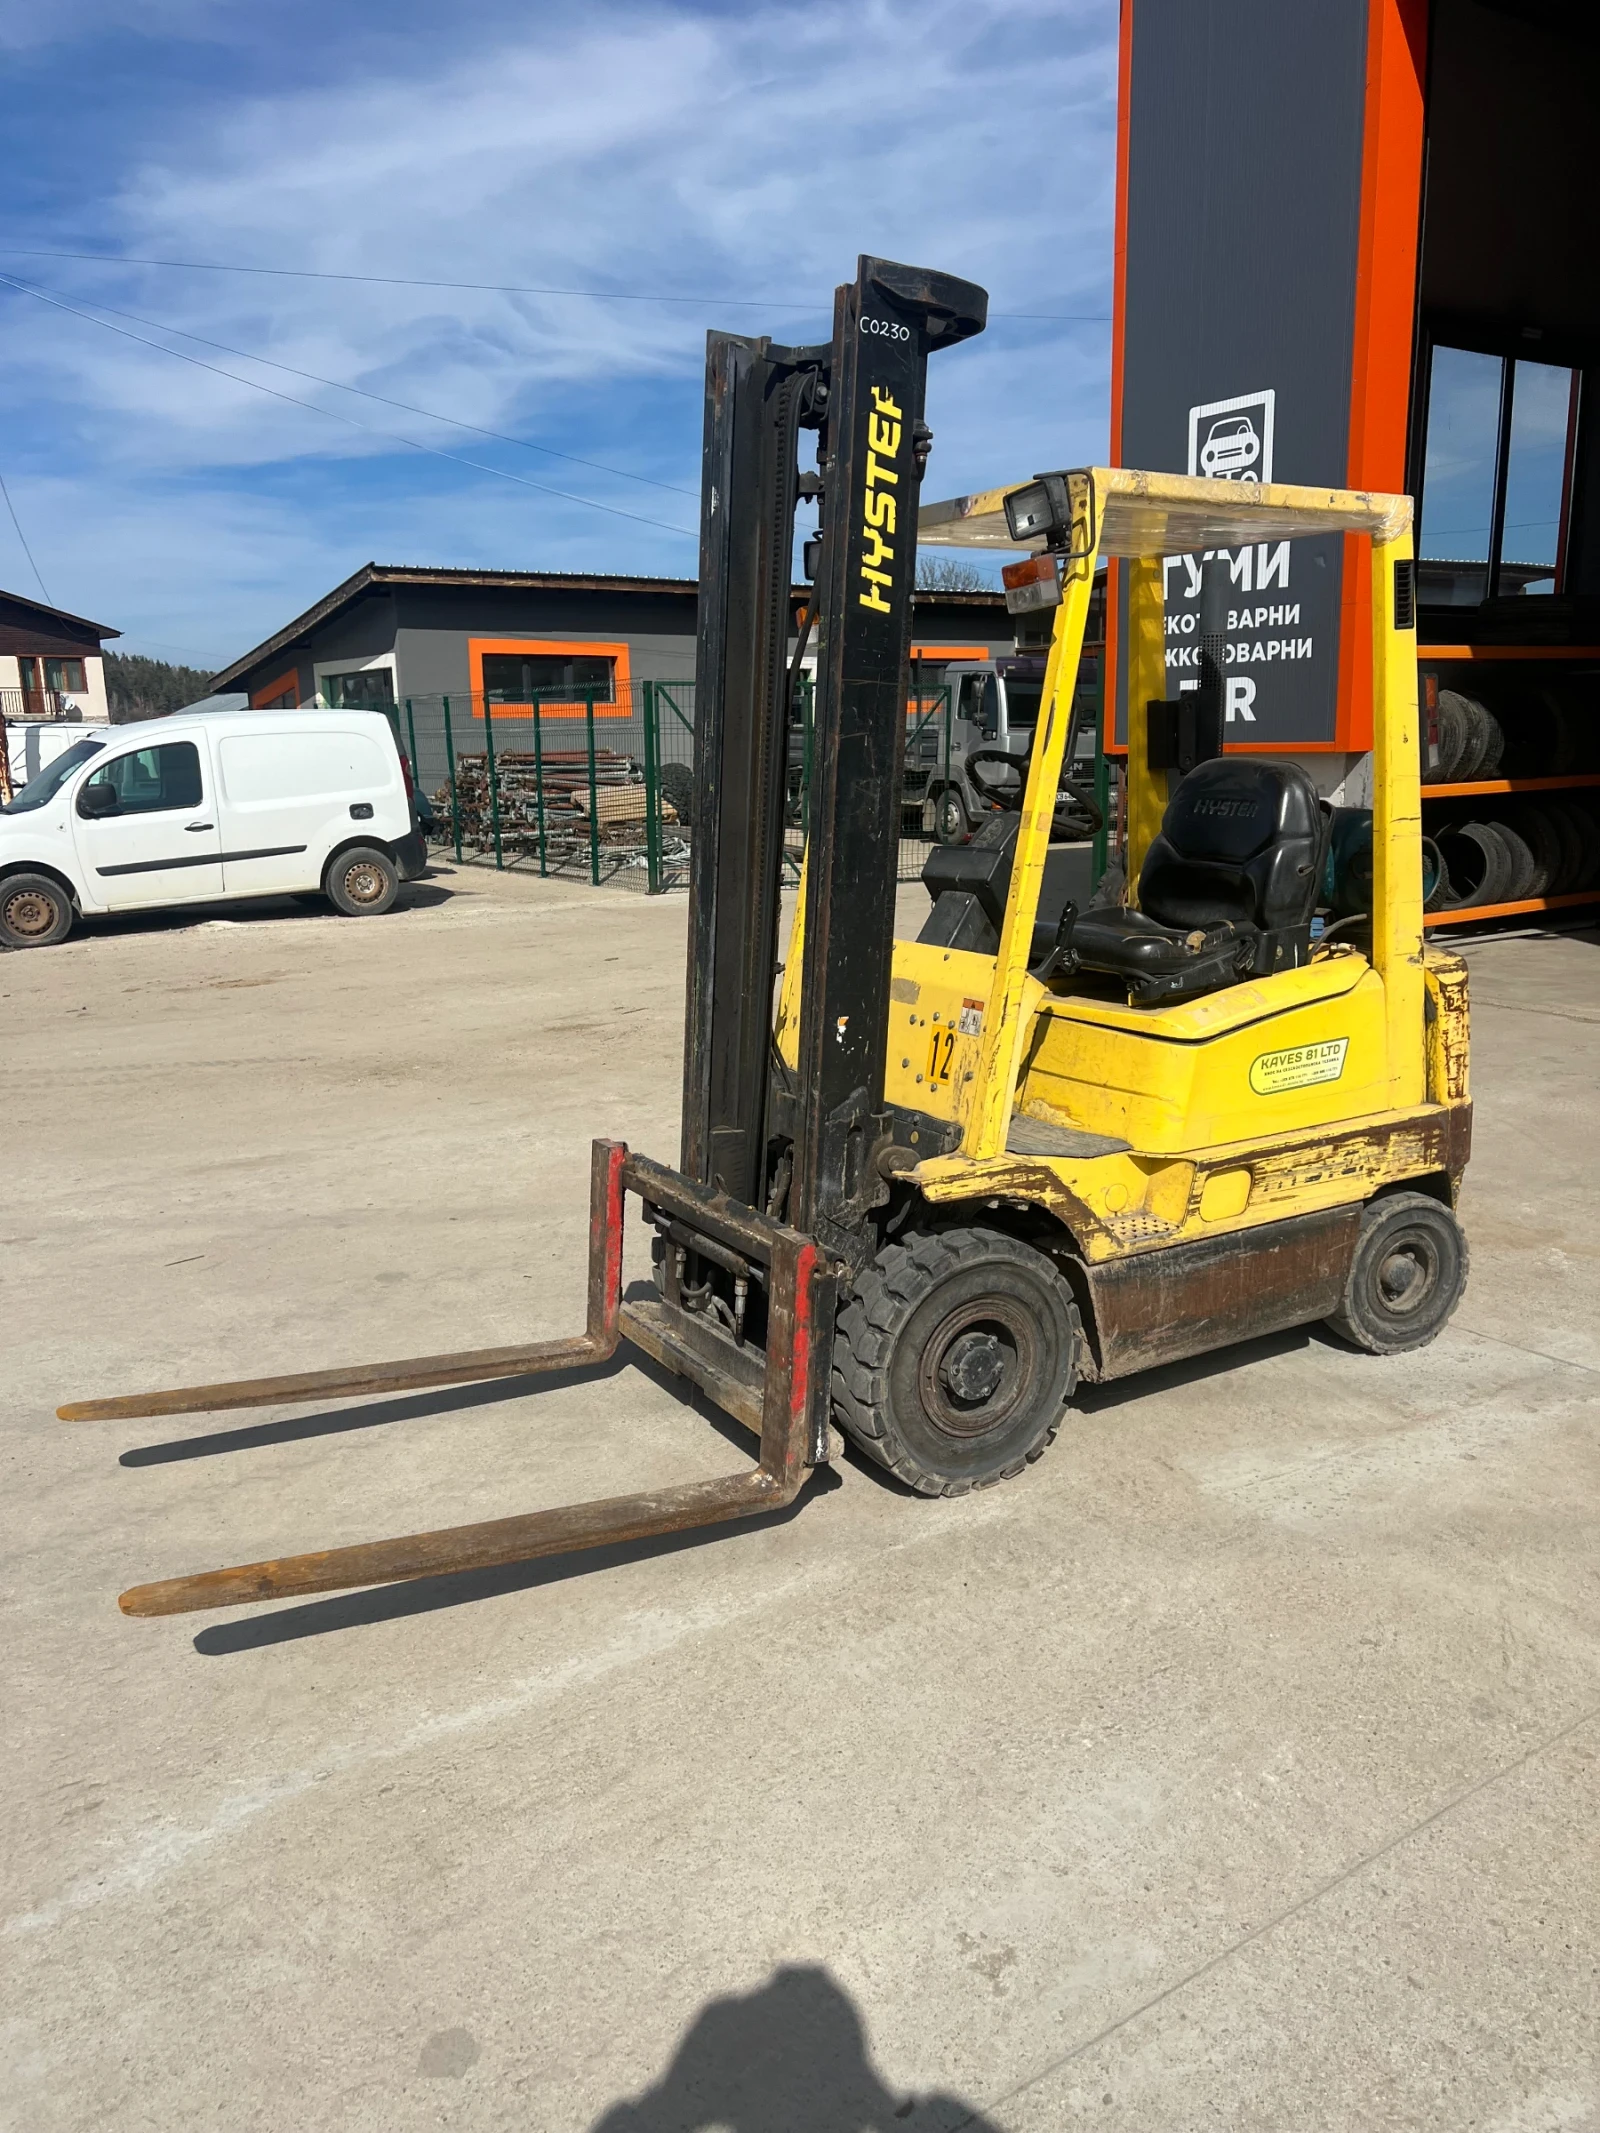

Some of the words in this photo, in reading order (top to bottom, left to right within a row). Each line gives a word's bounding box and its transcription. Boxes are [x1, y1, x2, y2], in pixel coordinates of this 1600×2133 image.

[932, 1031, 955, 1080] 12
[1261, 1052, 1303, 1070] KAVES
[1306, 1049, 1318, 1060] 81
[1320, 1044, 1341, 1058] LTD
